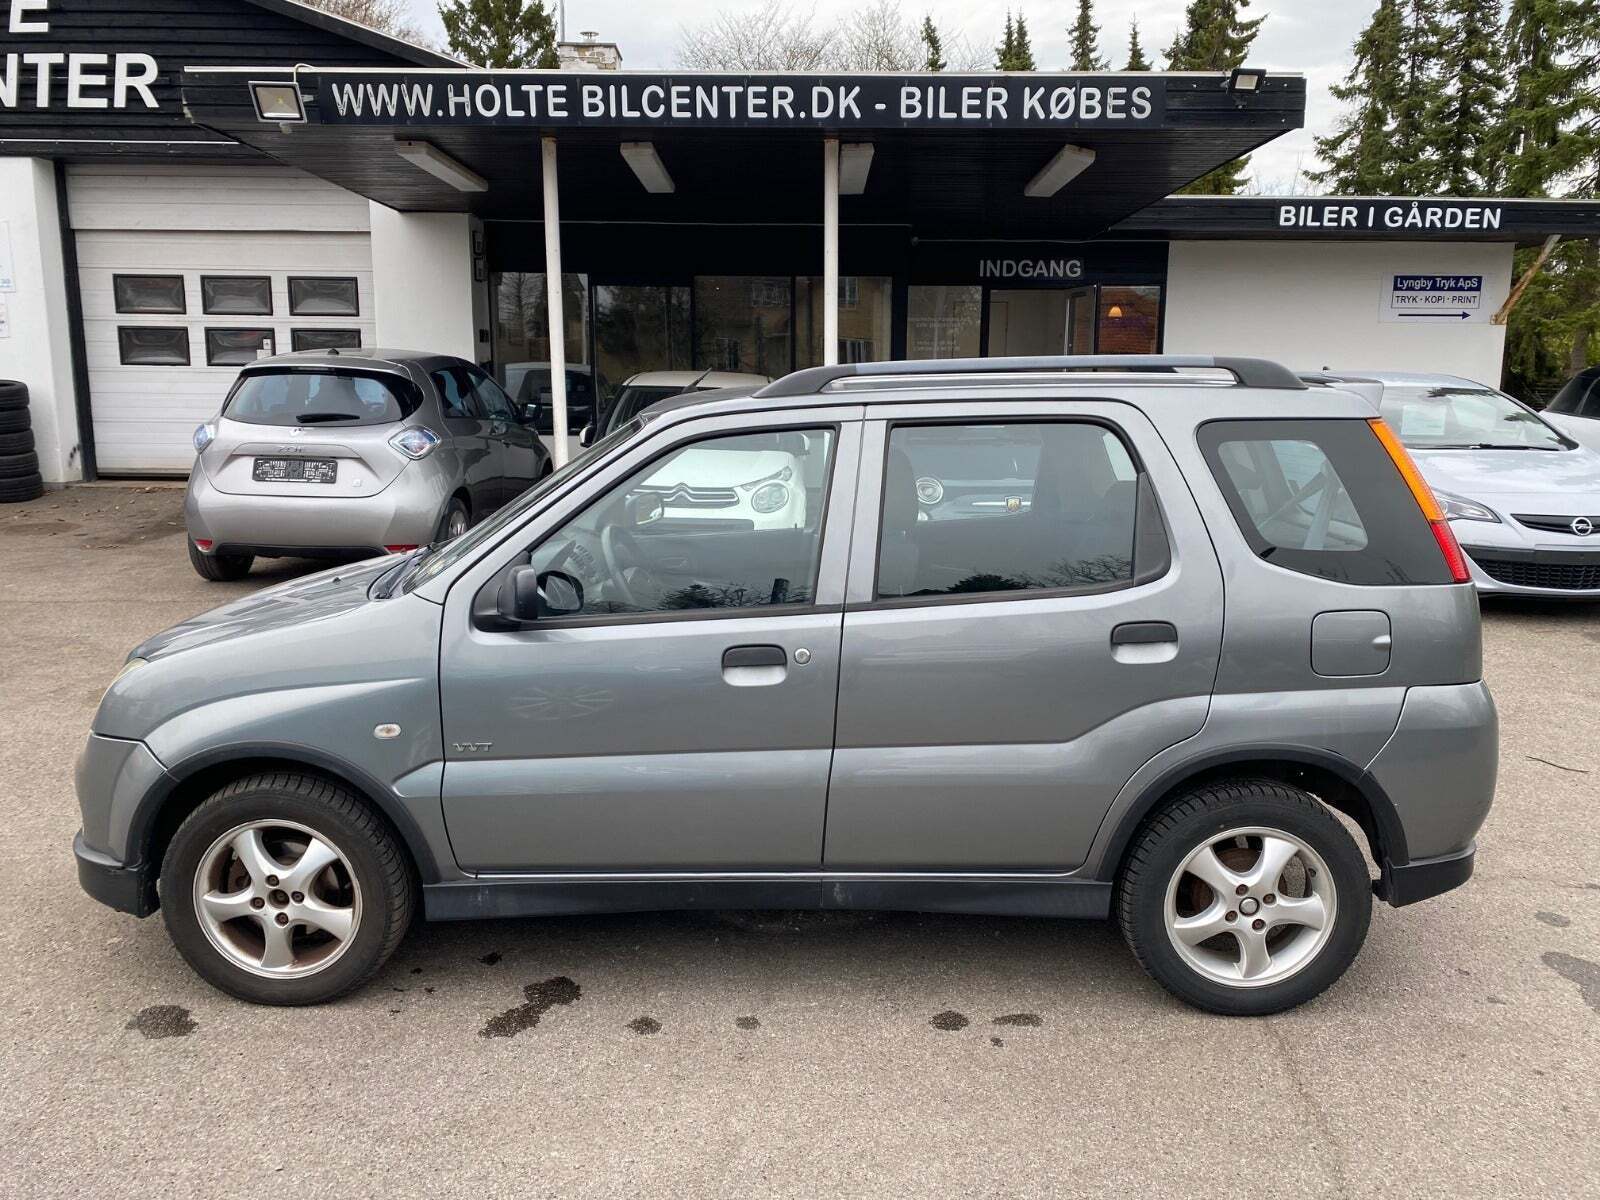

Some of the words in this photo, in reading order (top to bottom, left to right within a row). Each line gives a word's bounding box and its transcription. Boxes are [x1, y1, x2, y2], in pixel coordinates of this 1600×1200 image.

[331, 83, 569, 118] WWW.HOLTE
[582, 84, 862, 119] BILCENTER.DK
[900, 85, 1009, 120] BILER
[1023, 86, 1152, 120] KØBES
[1279, 205, 1358, 227] BILER
[1367, 206, 1375, 228] I
[1384, 201, 1502, 229] GÅRDEN
[979, 259, 1082, 278] INDGANG
[1397, 278, 1433, 289] Lyngby
[1435, 278, 1456, 290] Tryk
[1457, 278, 1479, 290] ApS
[1395, 295, 1418, 304] TRYK
[1424, 295, 1446, 304] KOPI
[1451, 295, 1478, 304] PRINT
